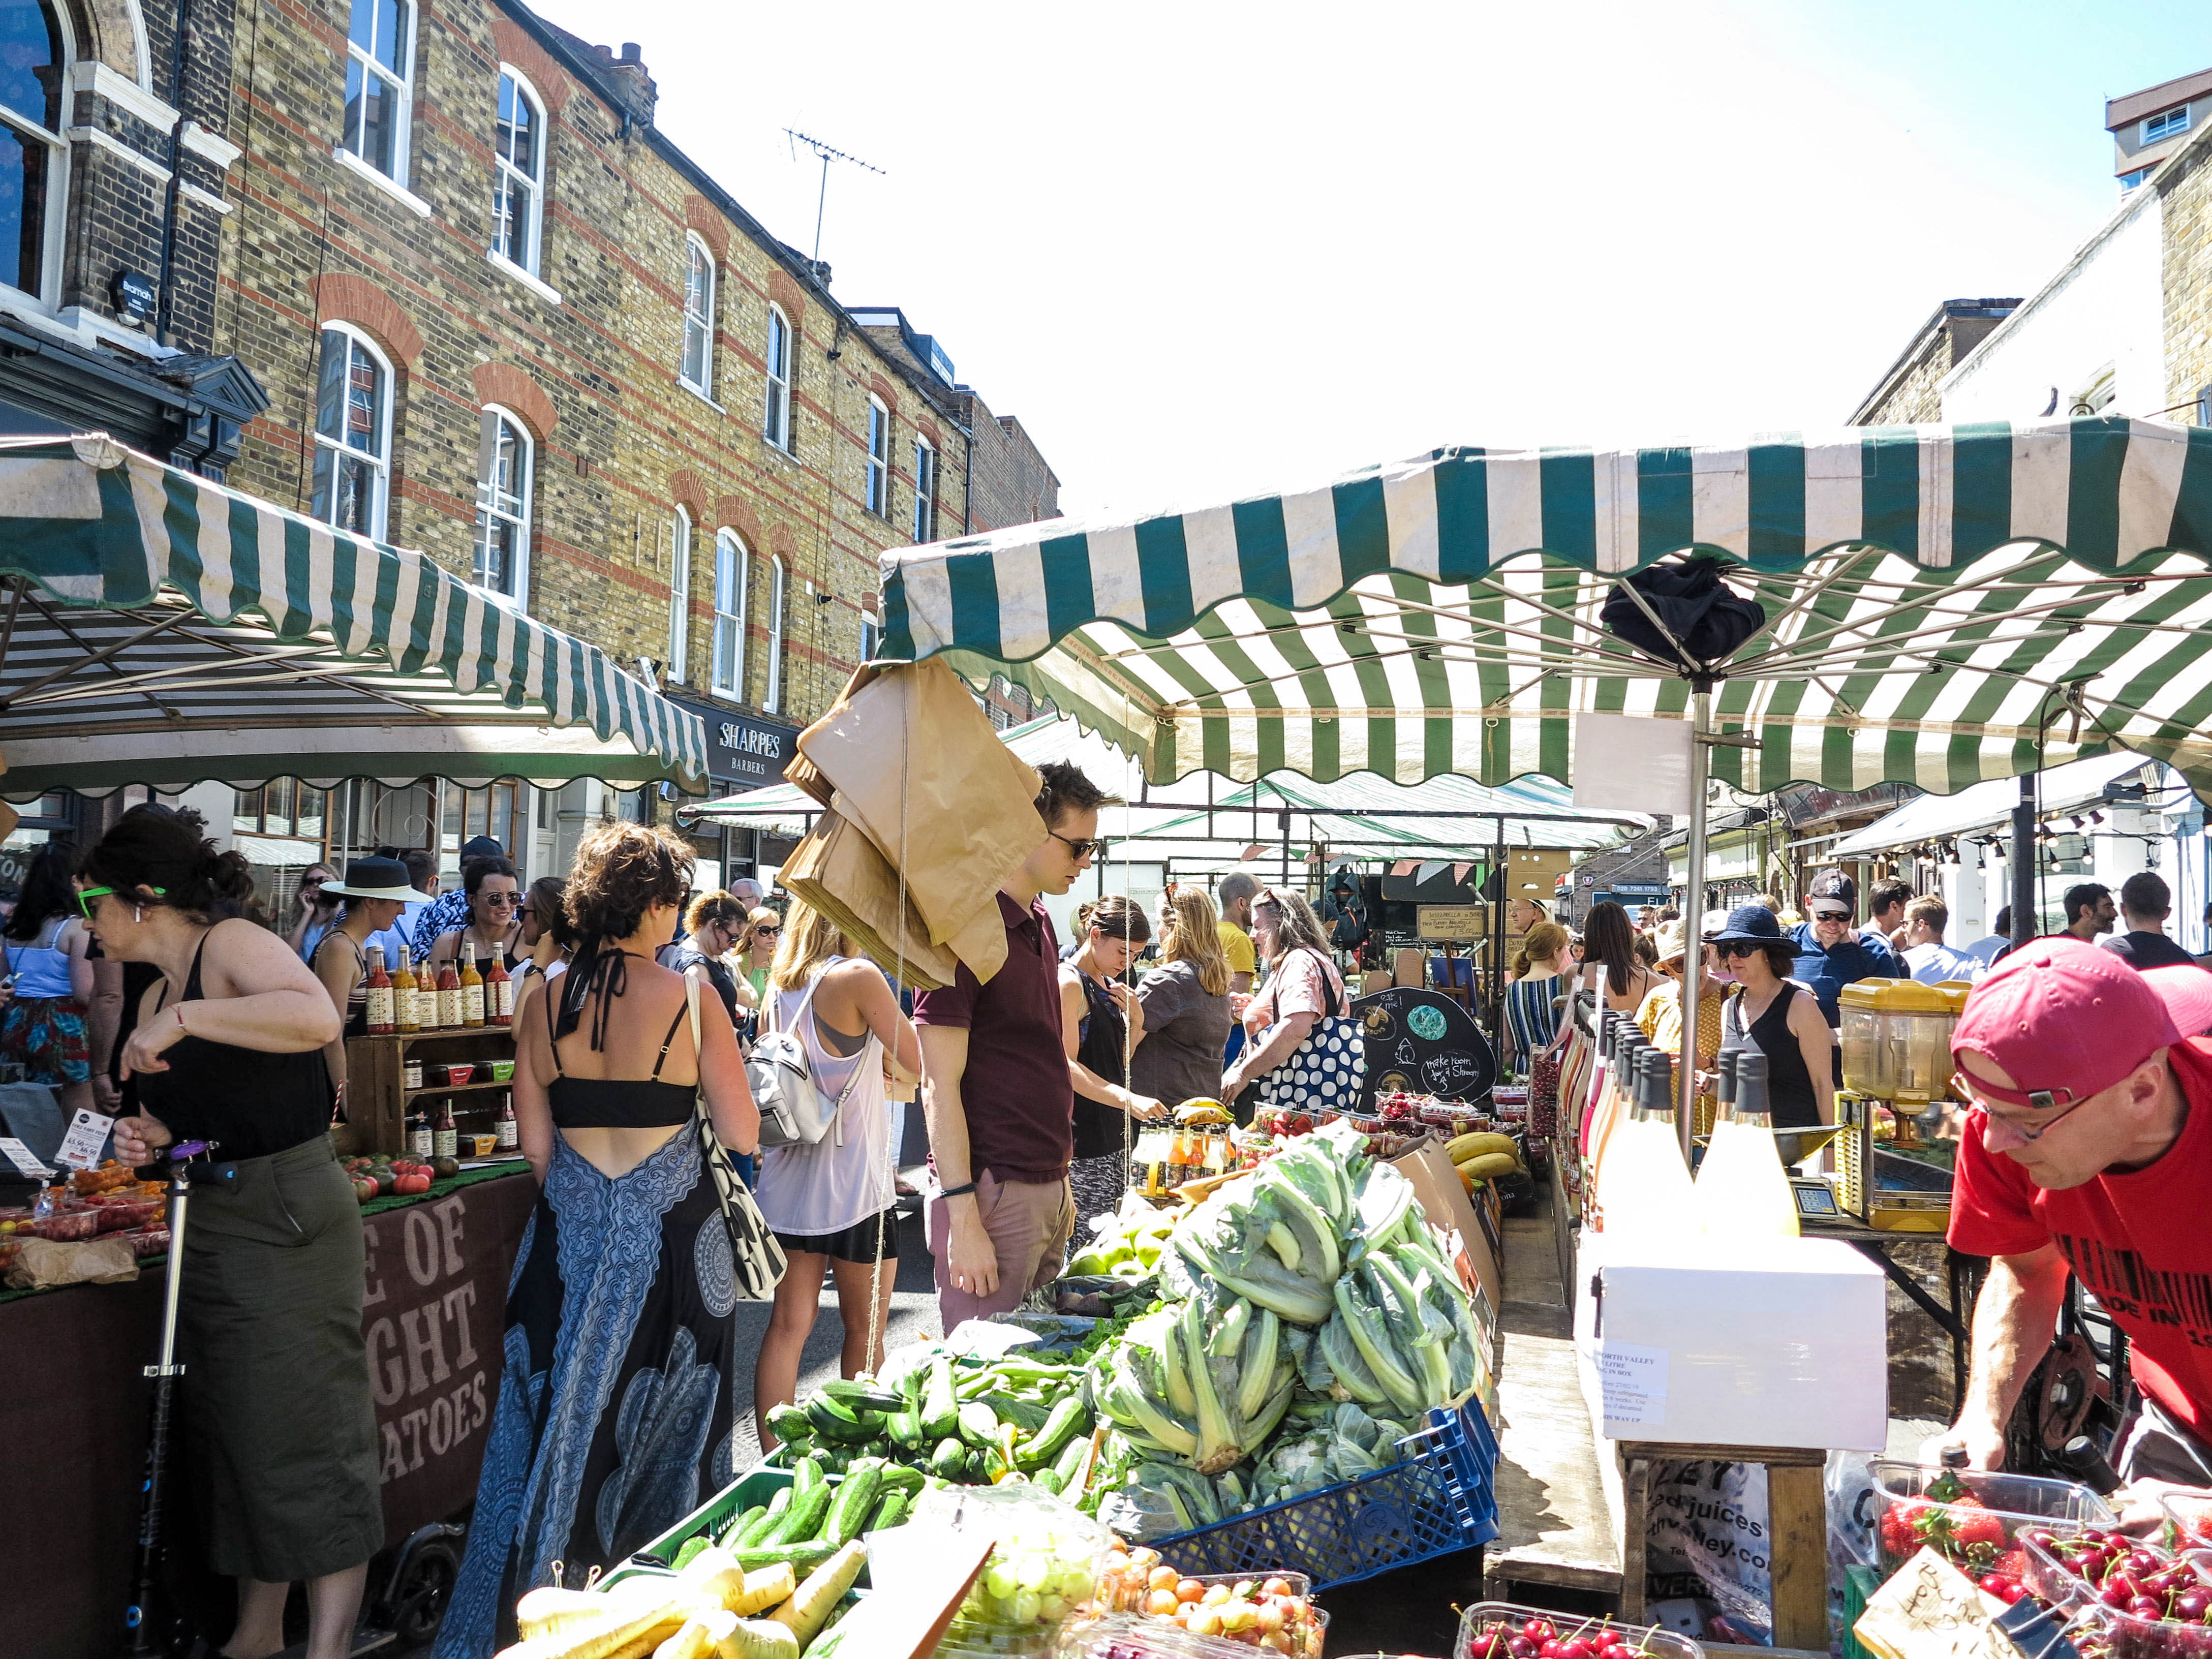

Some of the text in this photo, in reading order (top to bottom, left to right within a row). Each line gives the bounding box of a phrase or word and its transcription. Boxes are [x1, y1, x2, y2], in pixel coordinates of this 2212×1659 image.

[123, 280, 151, 301] Bramah
[720, 722, 780, 759] SHARPES
[731, 757, 765, 775] BARBERS
[1380, 992, 1395, 1001] eat
[1426, 1054, 1471, 1069] make room
[1430, 1069, 1443, 1082] for
[1445, 1067, 1450, 1077] a
[404, 1195, 466, 1286] OF
[2095, 1292, 2180, 1327] ADE IN
[366, 1280, 478, 1406] GHT
[1624, 1356, 1655, 1365] VALLEY
[380, 1370, 486, 1485] ATOES
[1685, 1500, 1763, 1538] juices
